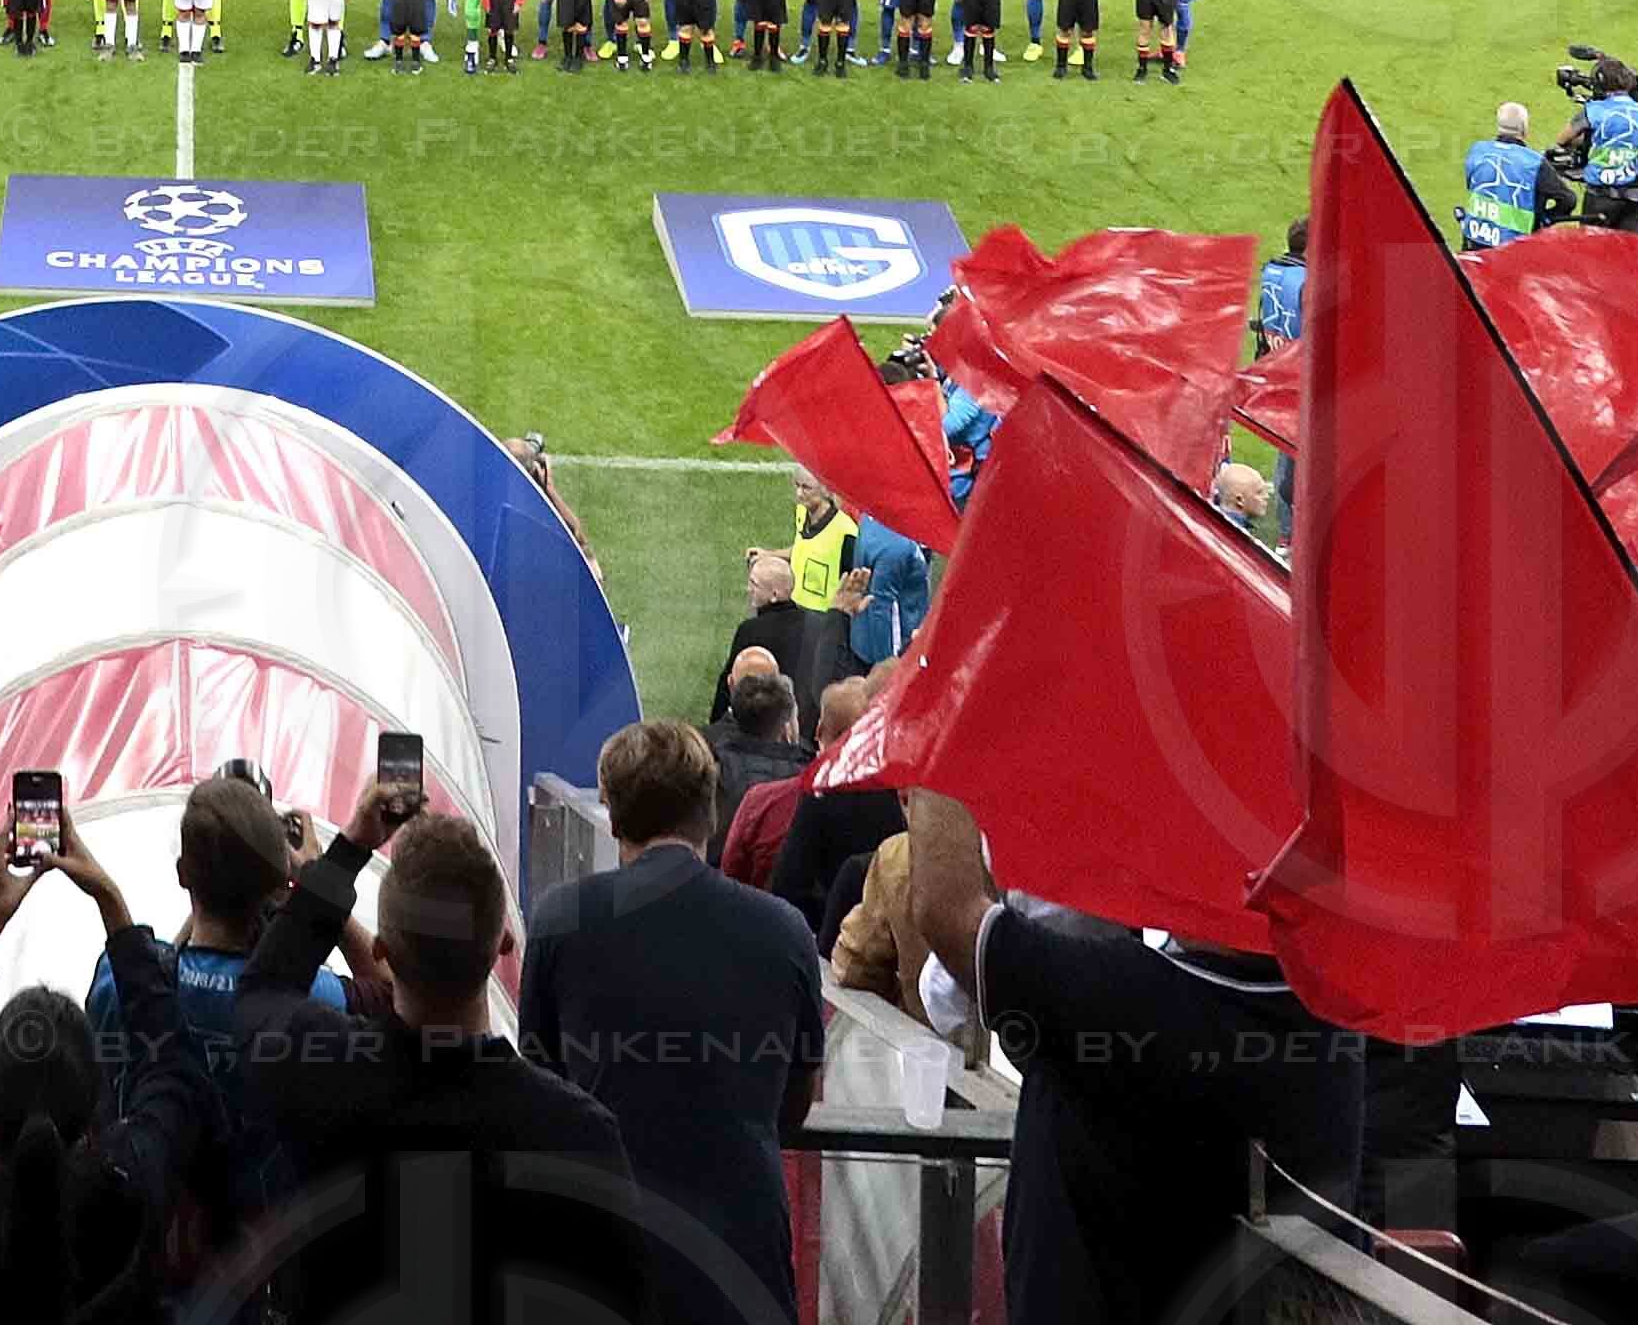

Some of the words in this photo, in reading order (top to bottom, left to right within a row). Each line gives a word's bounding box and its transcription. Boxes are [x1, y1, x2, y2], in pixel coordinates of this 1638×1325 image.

[1474, 200, 1500, 218] HB
[1469, 219, 1501, 247] 040
[135, 237, 235, 257] UEFA
[46, 251, 325, 276] CHAMPIONS
[115, 270, 256, 288] LEAGUE
